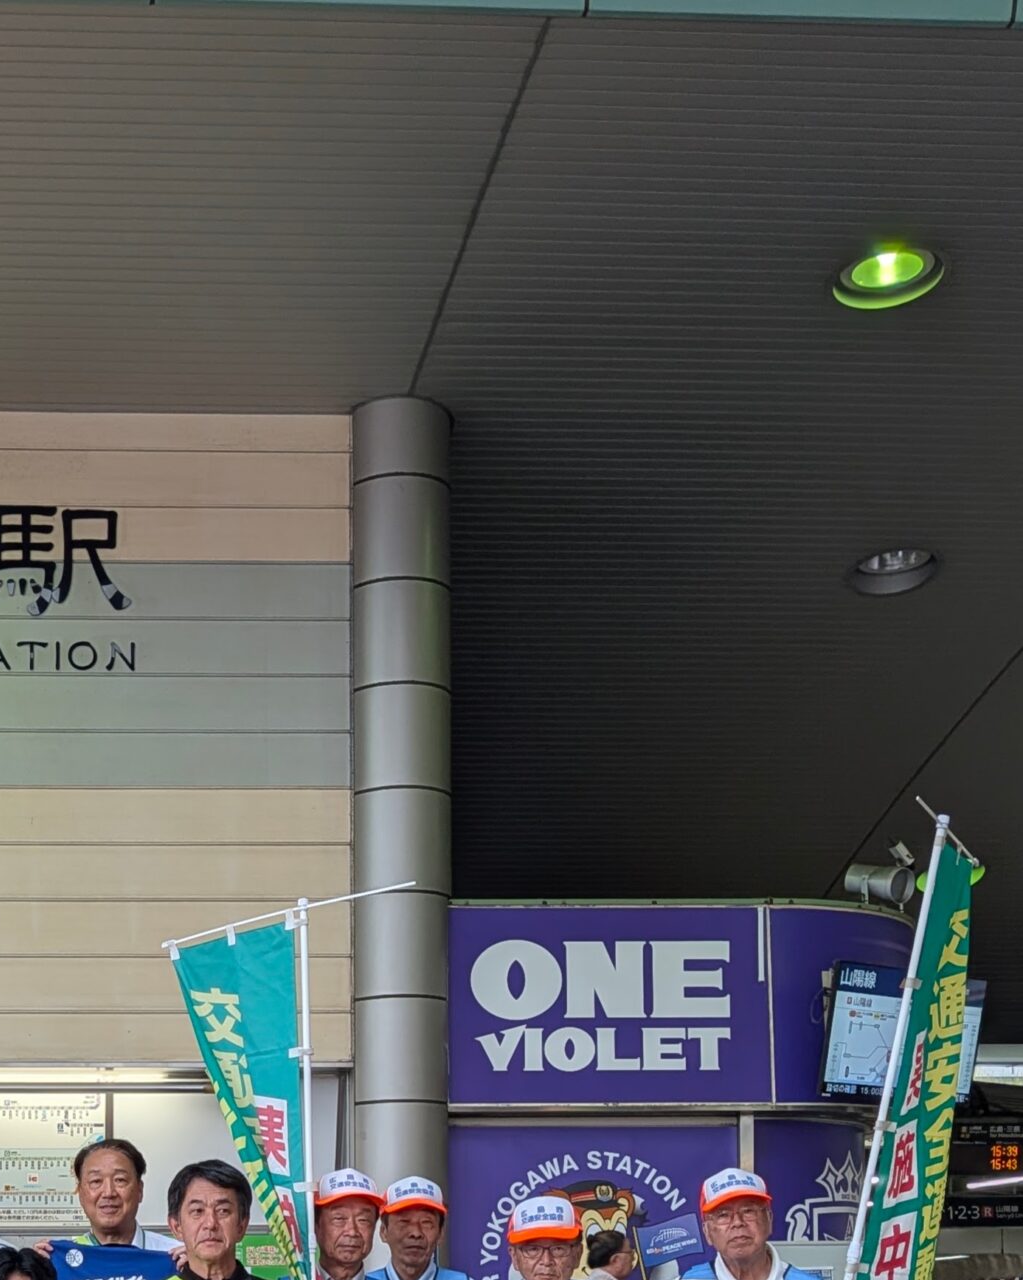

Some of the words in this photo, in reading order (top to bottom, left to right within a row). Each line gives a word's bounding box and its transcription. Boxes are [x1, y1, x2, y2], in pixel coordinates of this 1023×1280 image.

[470, 938, 731, 1021] ONE
[839, 967, 877, 989] 山陽線
[475, 1023, 731, 1072] VIOLET
[990, 1145, 1018, 1157] 15:39
[990, 1158, 1018, 1170] 15:43
[479, 1154, 580, 1266] YOKOGAWA
[586, 1150, 687, 1212] STATION
